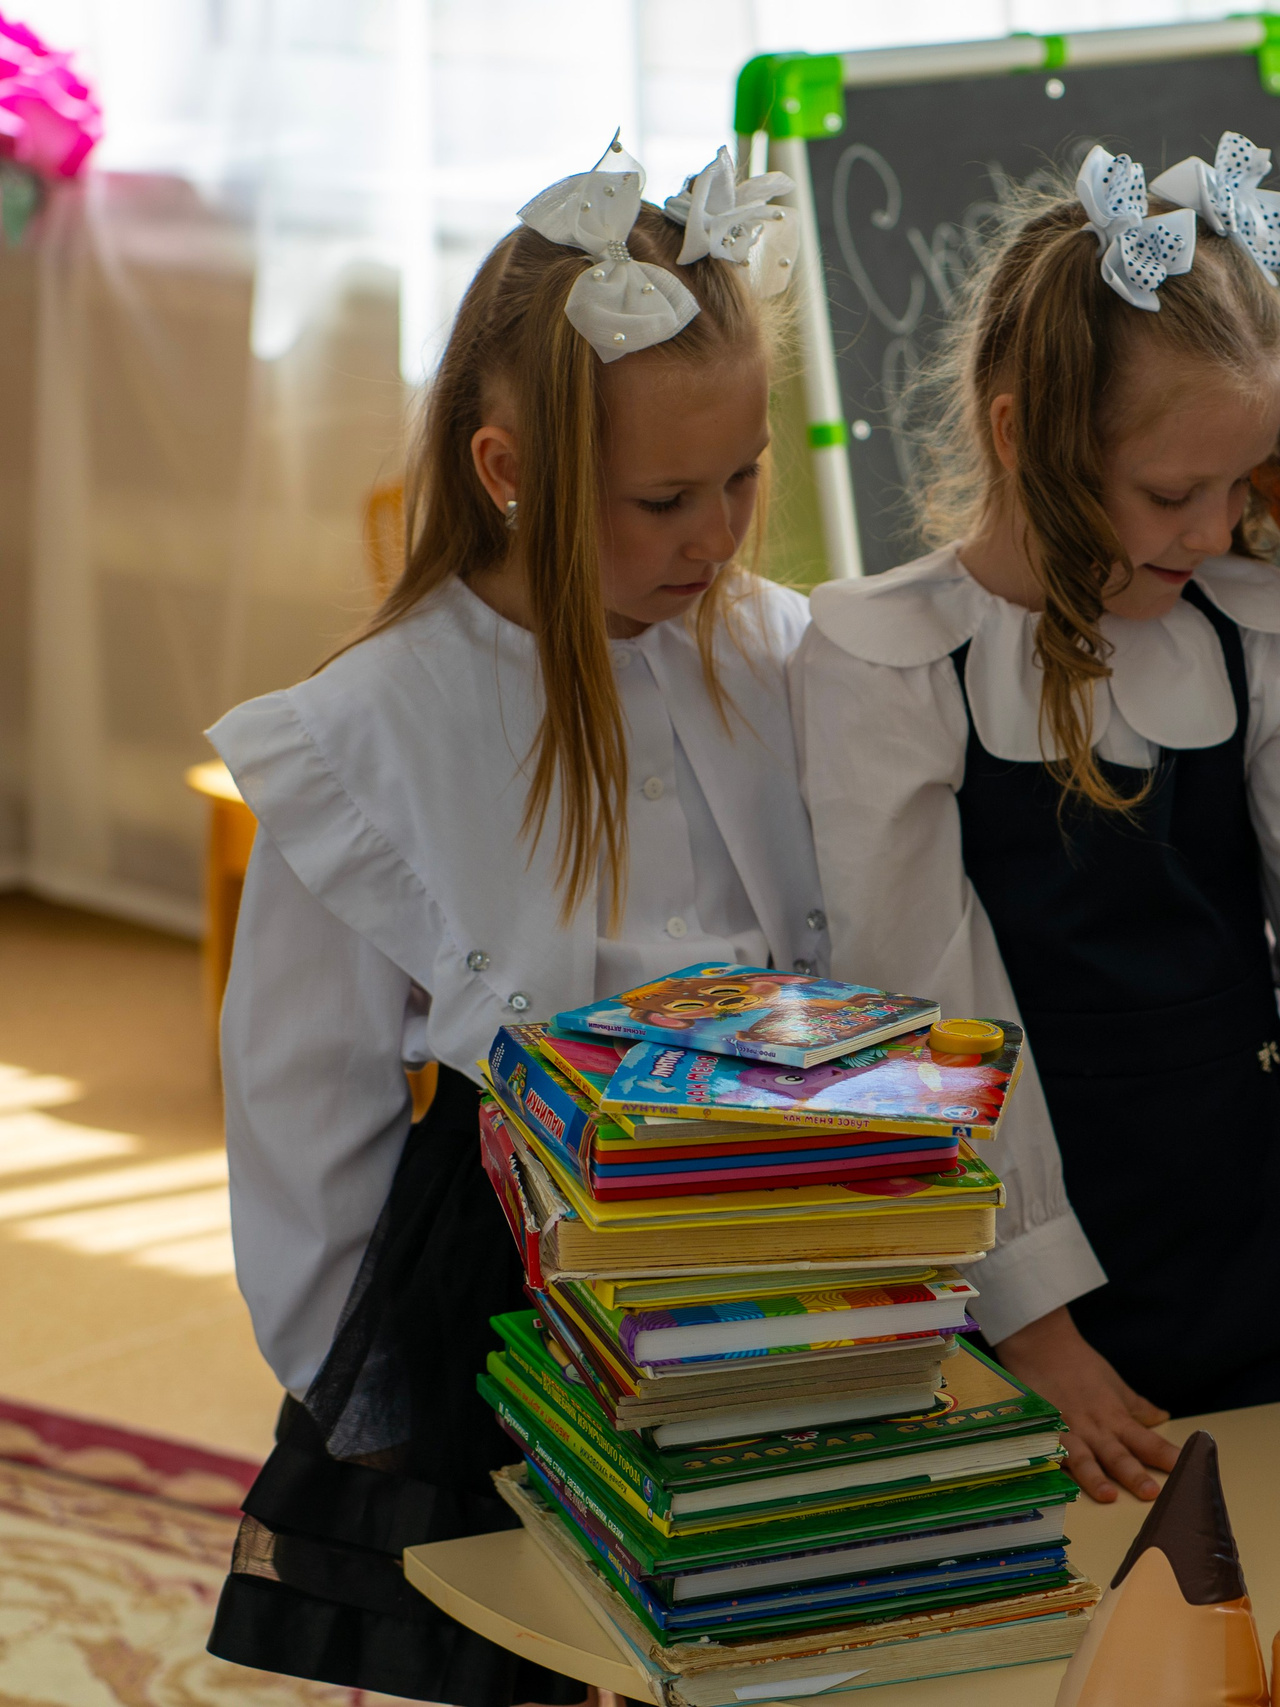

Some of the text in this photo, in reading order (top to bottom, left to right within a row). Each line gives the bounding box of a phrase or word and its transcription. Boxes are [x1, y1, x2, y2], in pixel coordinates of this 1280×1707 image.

[621, 1103, 678, 1115] ЛУНТИК
[783, 1113, 870, 1129] КАК МЕНЯ ЗОВУТ
[680, 1405, 1025, 1470] ЗОЛОТАЯ СЕРИЯ
